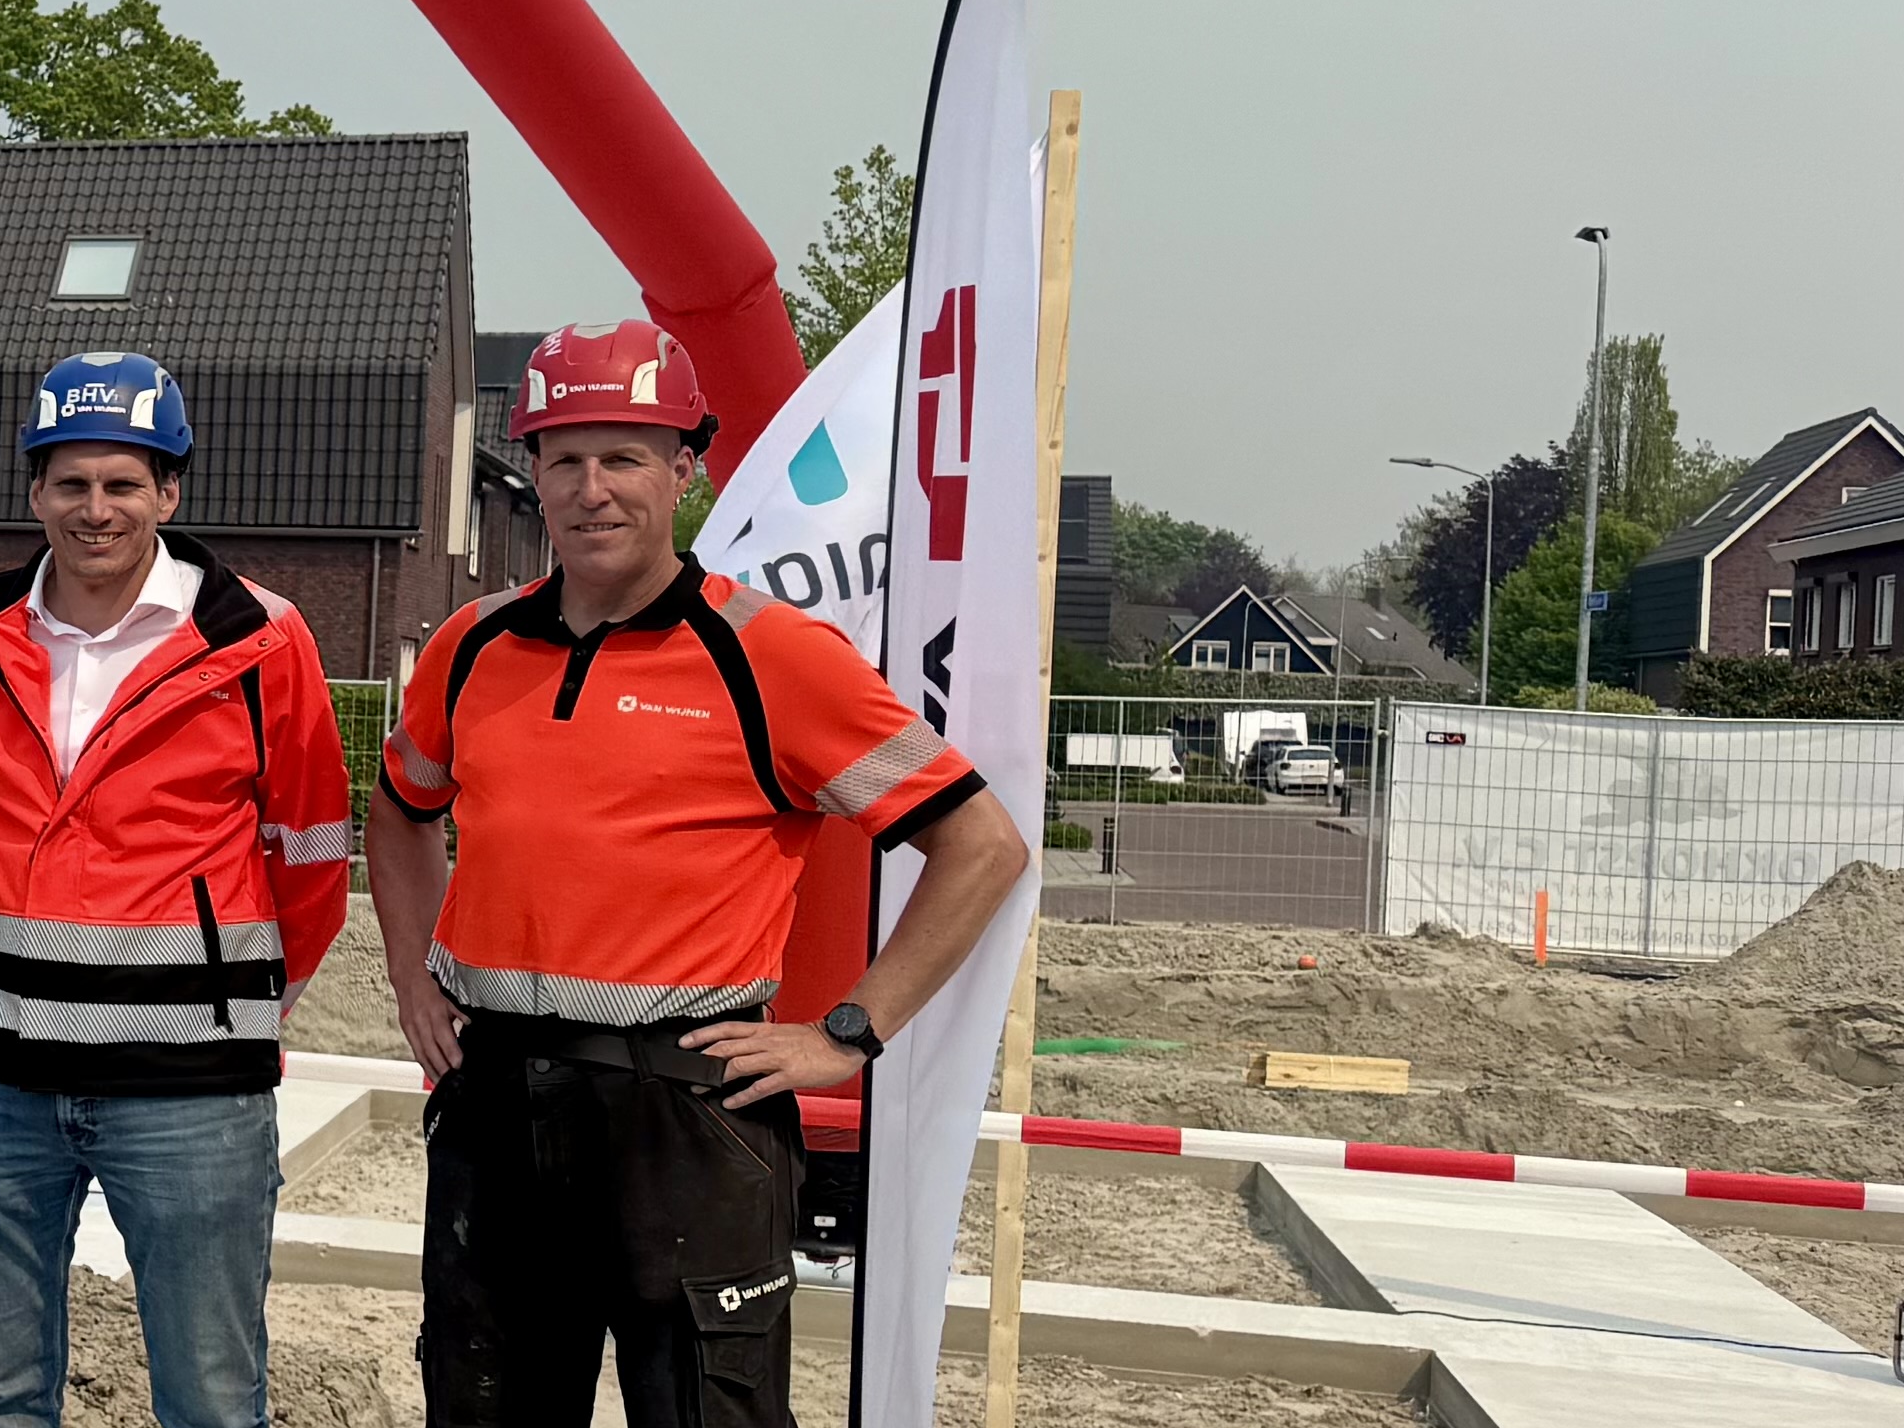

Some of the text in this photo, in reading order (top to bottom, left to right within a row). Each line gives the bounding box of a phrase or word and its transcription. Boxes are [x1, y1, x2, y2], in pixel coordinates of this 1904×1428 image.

[66, 387, 116, 404] BHV
[640, 702, 711, 720] VAN WIJNEN
[741, 1285, 763, 1301] VAN
